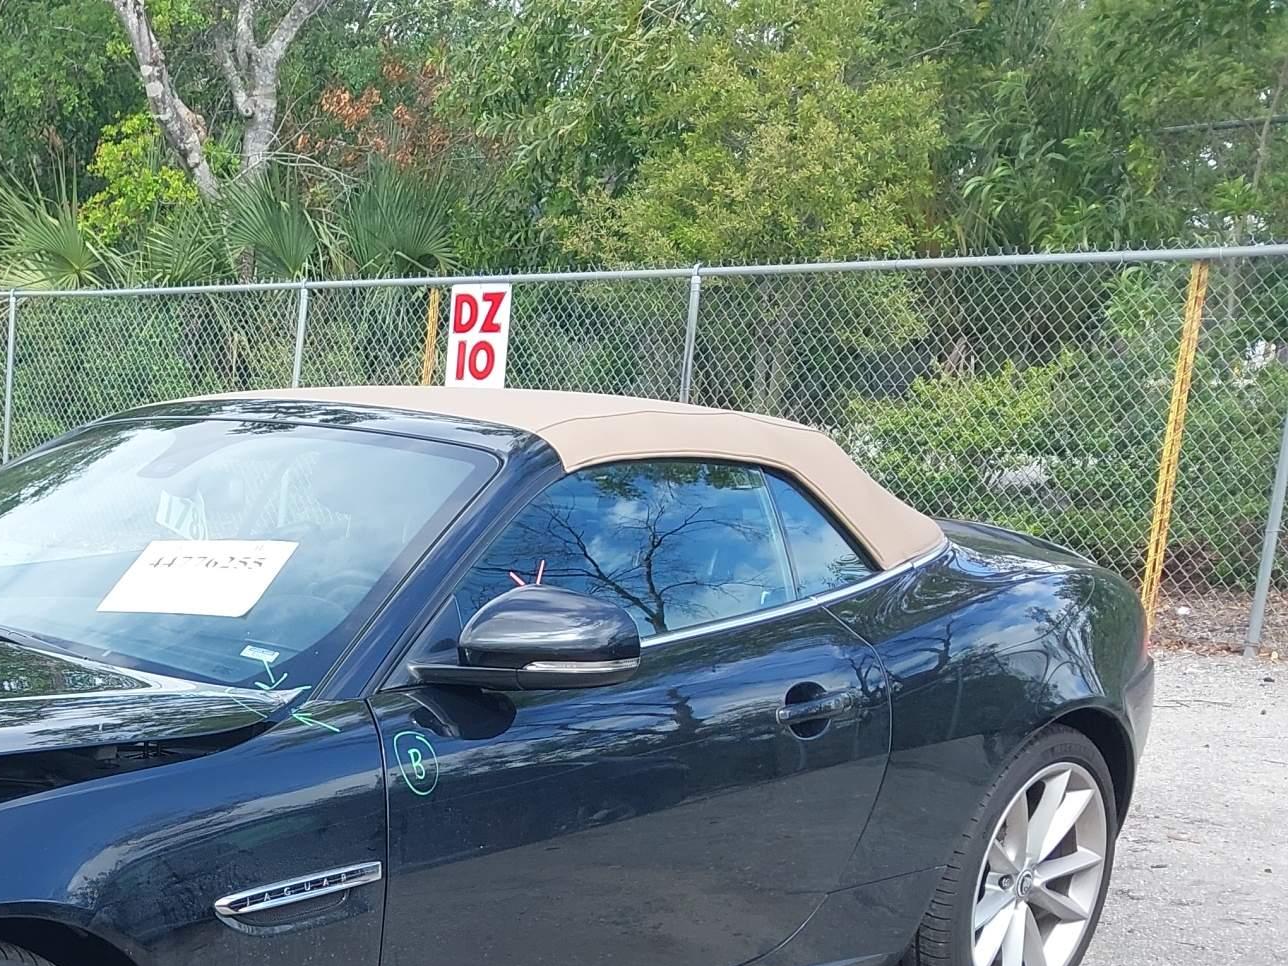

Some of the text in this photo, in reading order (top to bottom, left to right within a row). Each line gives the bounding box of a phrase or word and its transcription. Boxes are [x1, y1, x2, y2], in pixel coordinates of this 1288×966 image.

[453, 292, 507, 334] DZ
[455, 340, 495, 381] 10
[407, 748, 426, 780] B
[245, 873, 347, 907] JAGUAR
